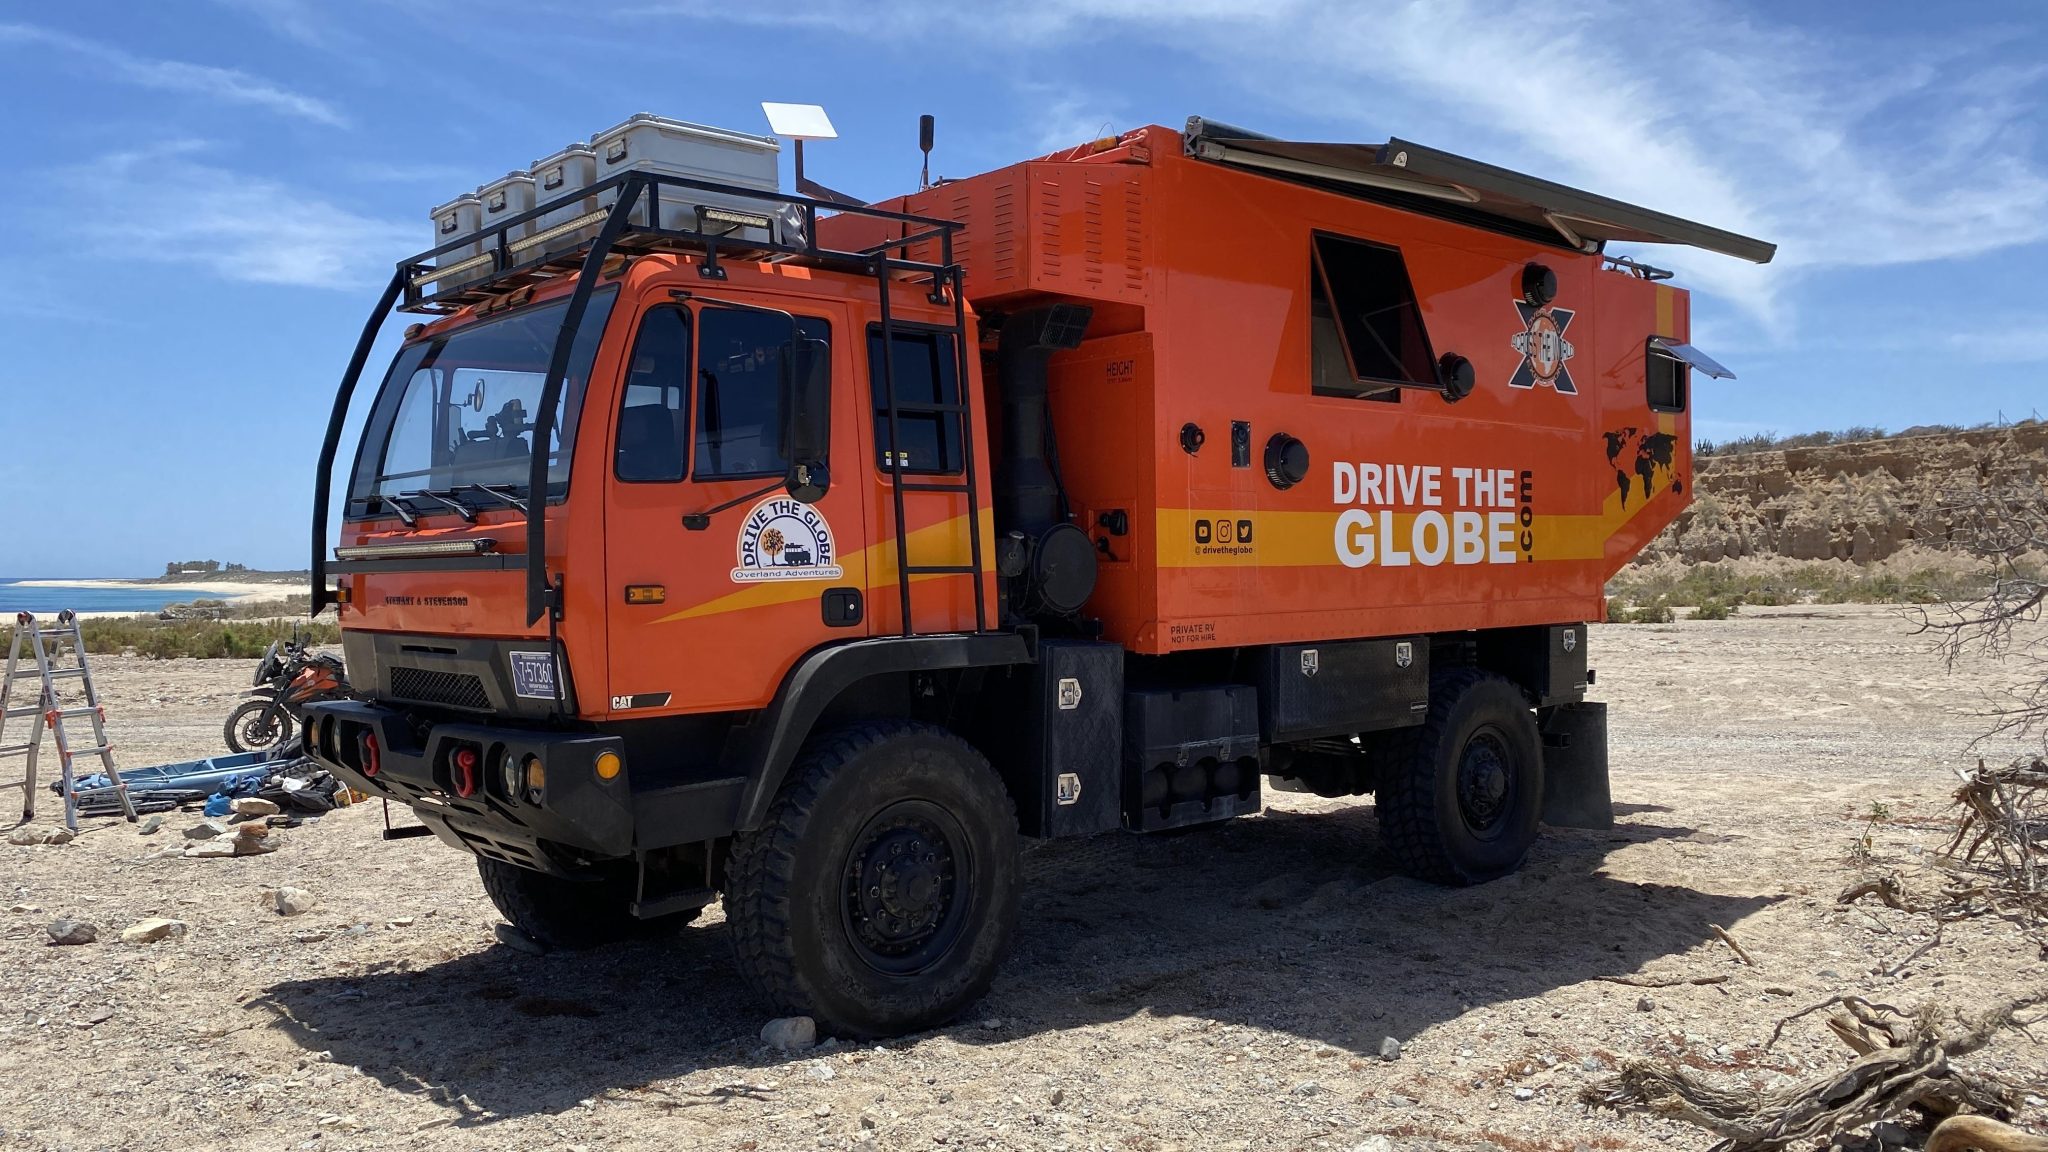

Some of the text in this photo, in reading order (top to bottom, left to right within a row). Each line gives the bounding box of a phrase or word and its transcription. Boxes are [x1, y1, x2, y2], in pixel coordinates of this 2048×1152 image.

[1106, 360, 1134, 377] HEIGHT
[1333, 461, 1516, 508] DRIVE THE
[1520, 470, 1533, 563] .com
[742, 500, 831, 567] DRIVE THE GLOBE
[1334, 508, 1517, 568] GLOBE
[735, 569, 840, 579] Overland Adventures
[424, 596, 469, 607] STEVENSON
[1170, 623, 1216, 635] PRIVATE RV
[1171, 633, 1216, 644] NOT FOR HIRE
[612, 695, 634, 710] CAT
